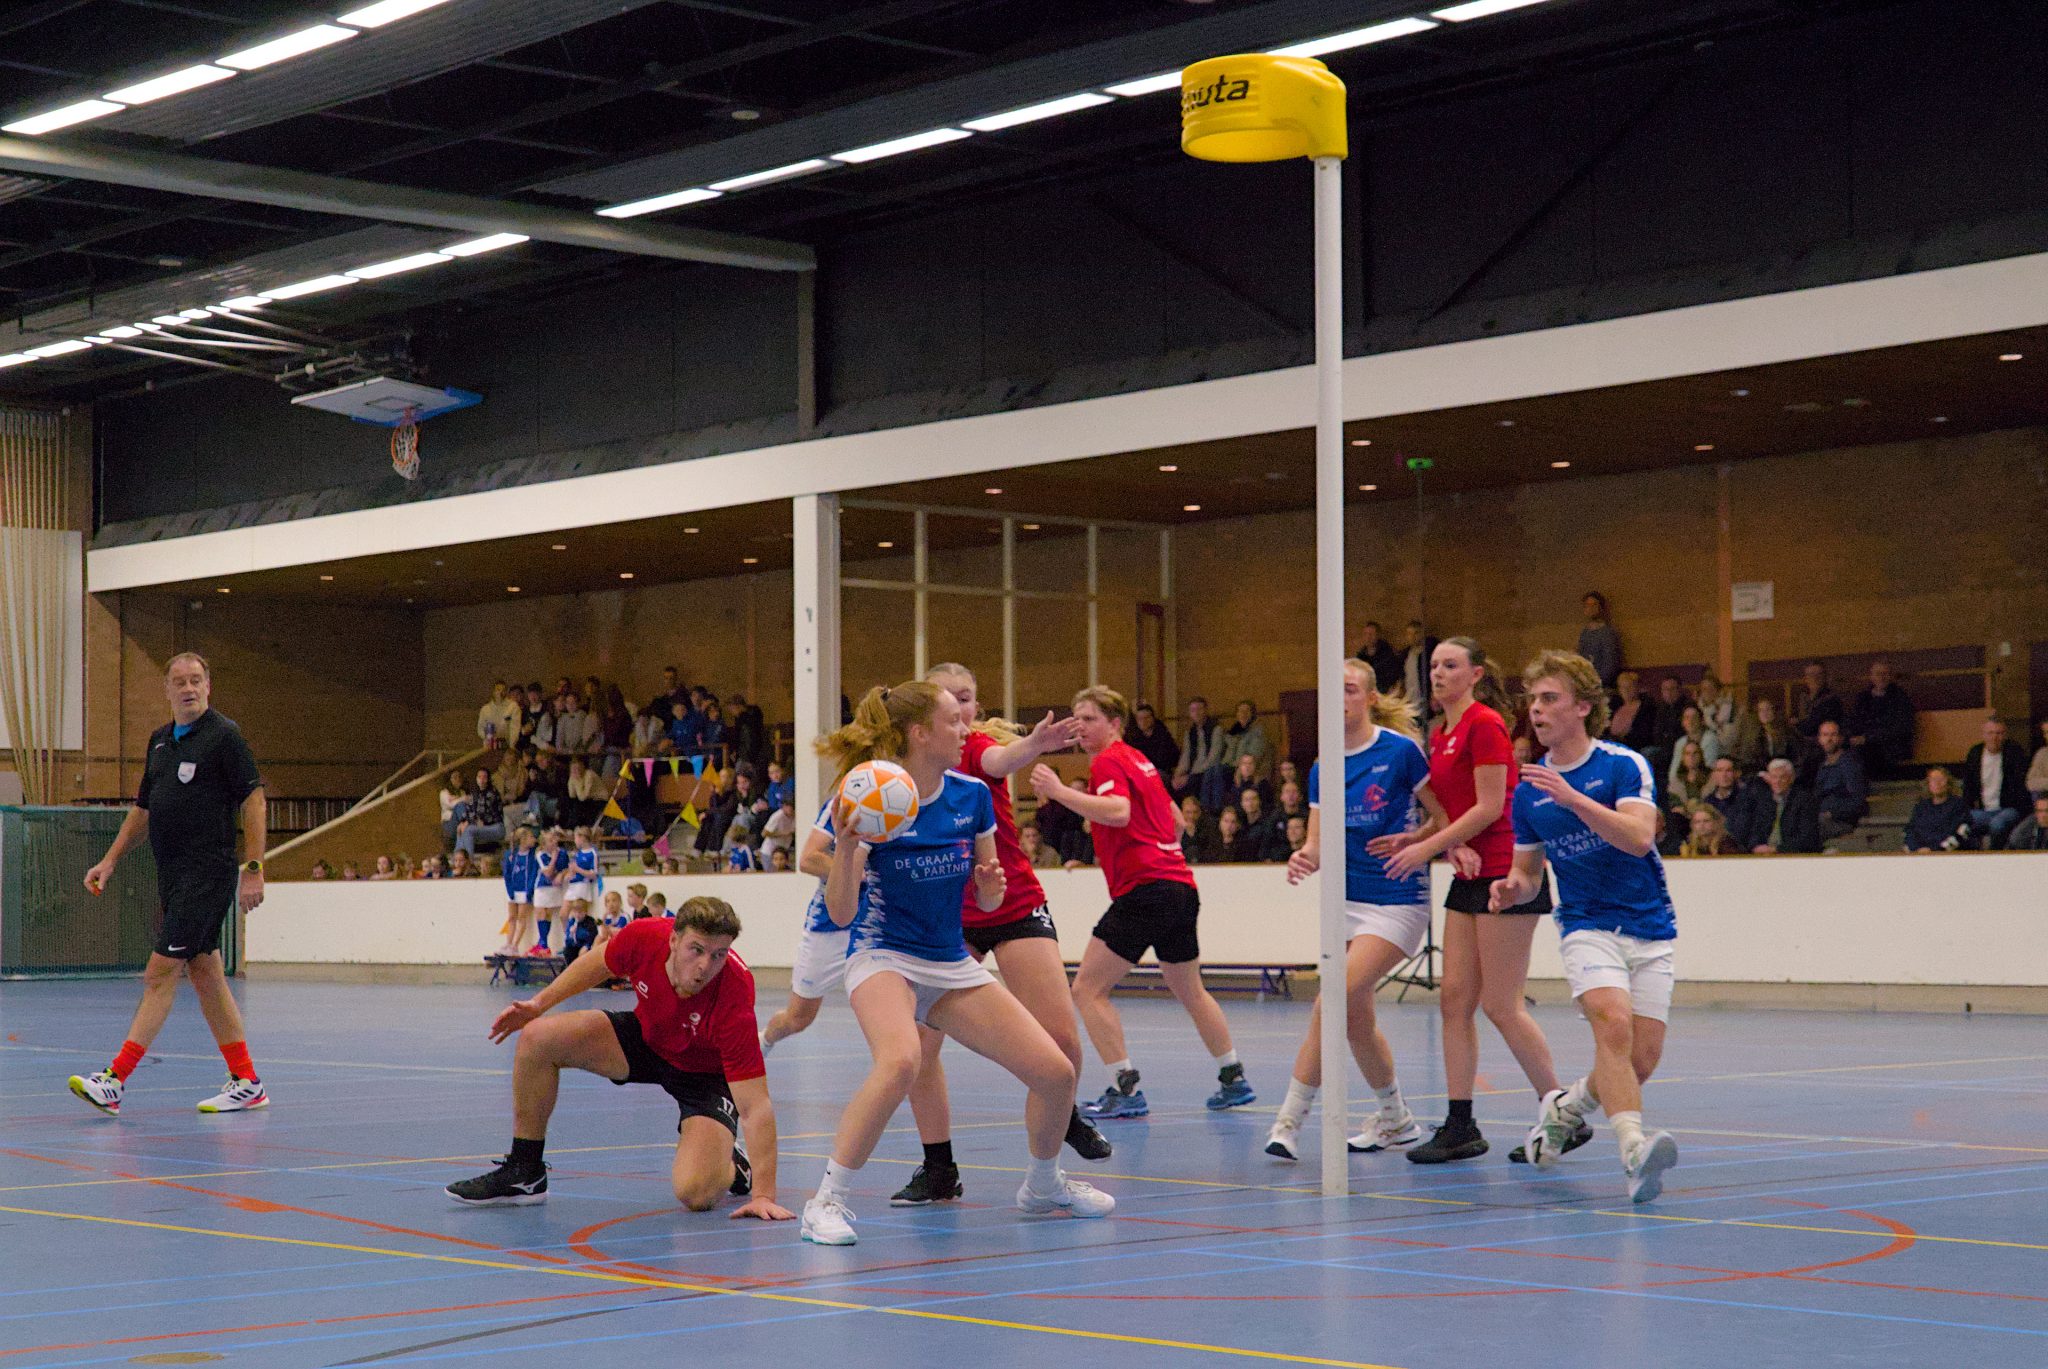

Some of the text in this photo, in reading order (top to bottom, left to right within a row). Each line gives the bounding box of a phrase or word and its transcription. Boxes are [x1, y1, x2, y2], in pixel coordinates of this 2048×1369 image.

[895, 852, 955, 870] DE GRAAF
[911, 869, 919, 879] &
[721, 1096, 735, 1115] 17
